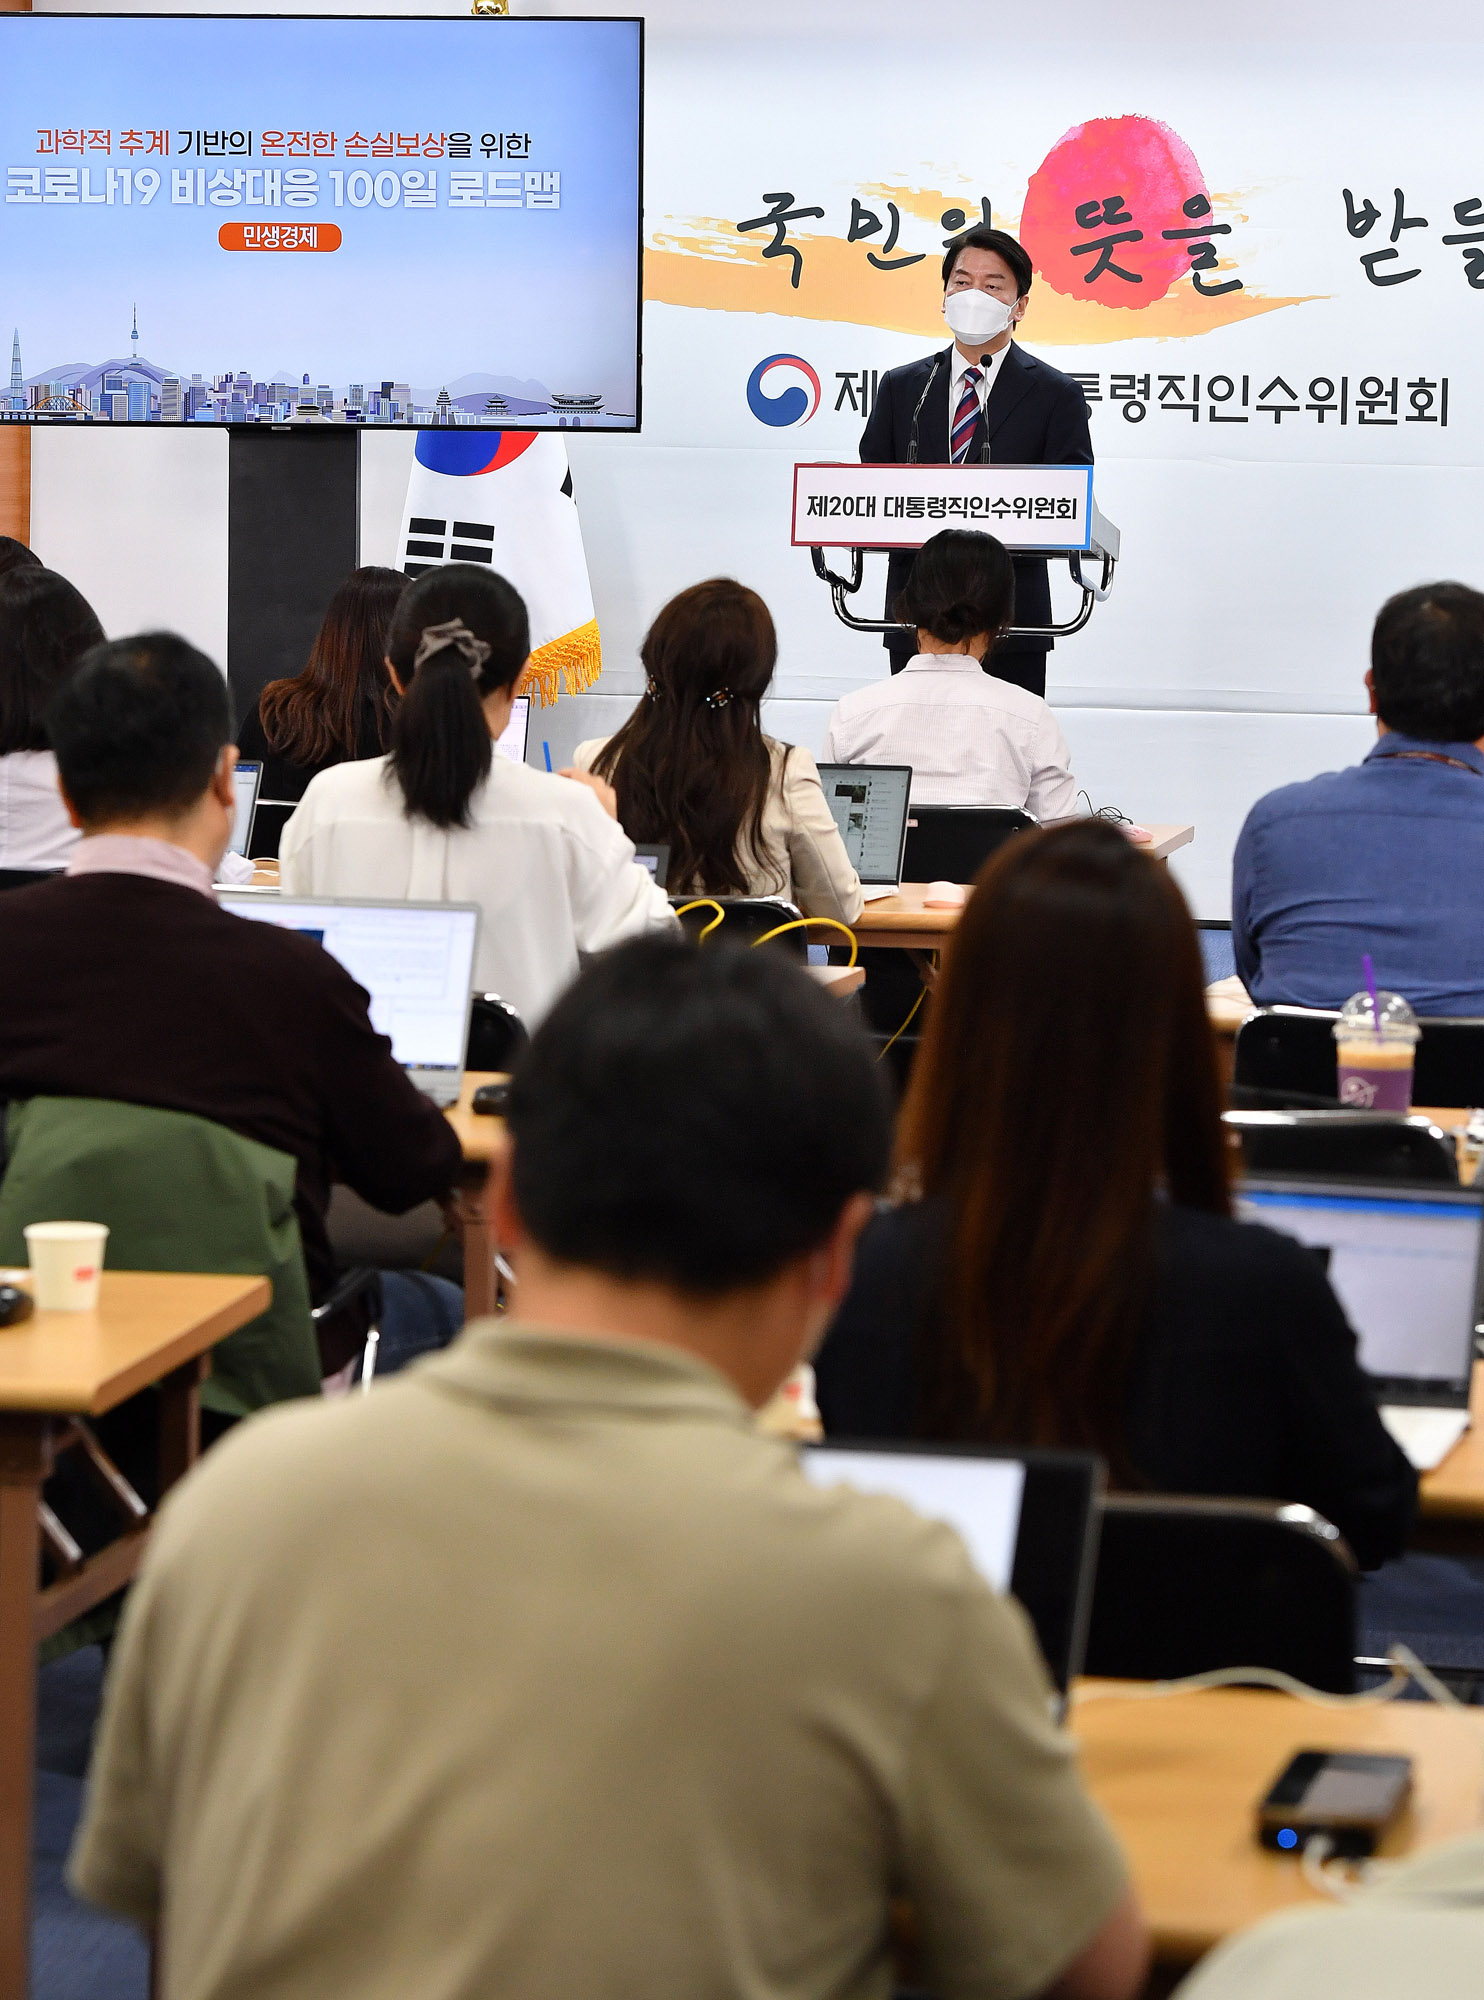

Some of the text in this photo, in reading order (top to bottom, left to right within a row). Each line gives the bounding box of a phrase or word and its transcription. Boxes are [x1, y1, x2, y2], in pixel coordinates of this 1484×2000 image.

[36, 129, 532, 160] 과학적 추계 기반의 온전한 손실보상을 위한
[5, 166, 561, 210] 코로나19 비상대응 100일 로드맵
[243, 225, 318, 249] 민생경제
[1070, 193, 1244, 297] 뜻을
[806, 495, 1078, 521] 제20대 대통령직인수위원회
